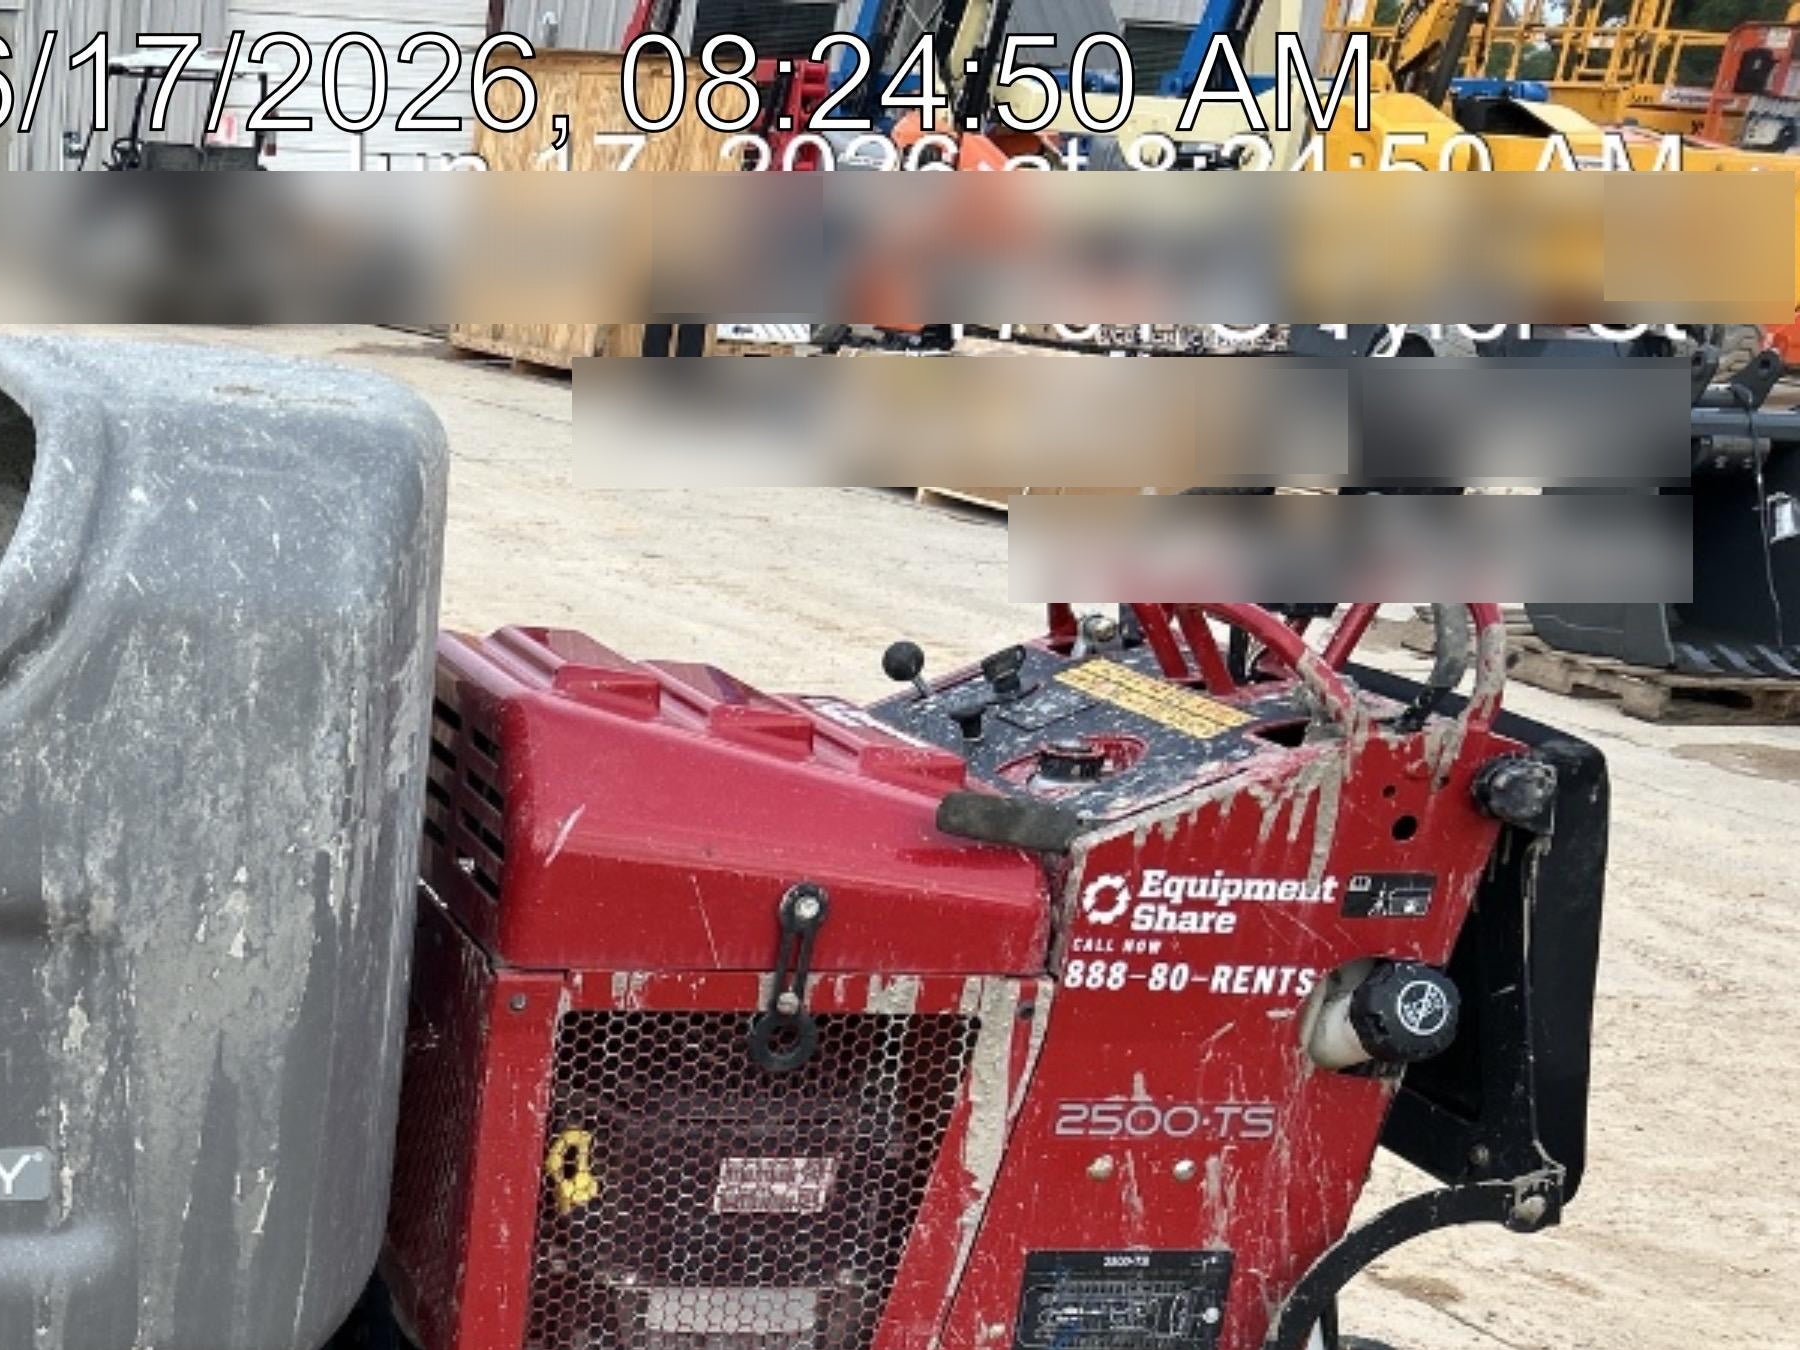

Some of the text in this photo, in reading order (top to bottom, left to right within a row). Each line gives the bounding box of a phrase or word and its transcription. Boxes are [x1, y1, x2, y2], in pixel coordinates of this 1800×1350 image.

[1139, 869, 1337, 907] Equipment
[1131, 904, 1236, 934] Share
[1073, 938, 1161, 954] CALL NOW
[1064, 960, 1316, 997] 888-80-RENTS
